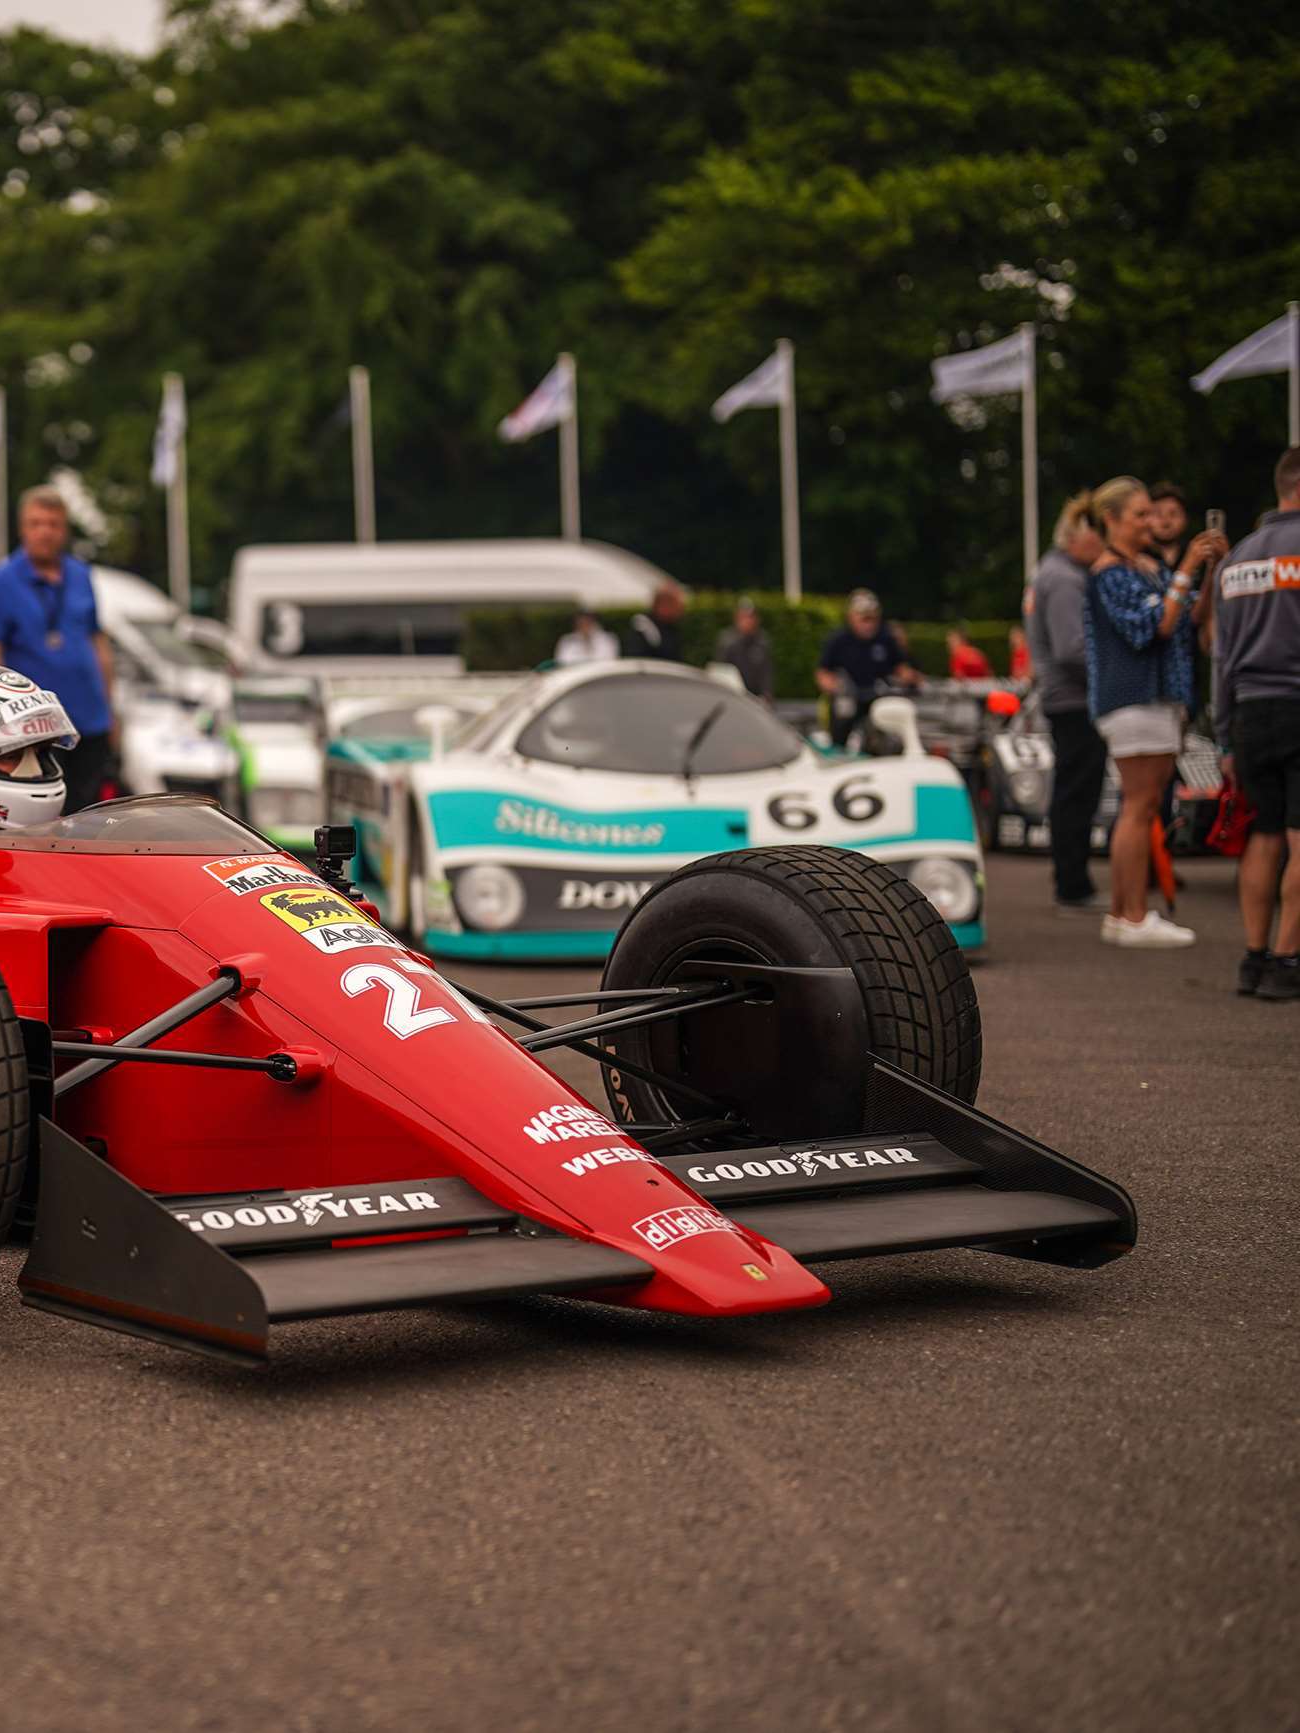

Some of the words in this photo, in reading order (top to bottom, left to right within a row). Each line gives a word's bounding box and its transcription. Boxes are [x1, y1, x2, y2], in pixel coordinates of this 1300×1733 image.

[767, 774, 885, 832] 66
[320, 925, 397, 947] Agip
[340, 957, 494, 1040] 27
[561, 1147, 664, 1177] WEBE
[687, 1147, 920, 1183] GOODYEAR
